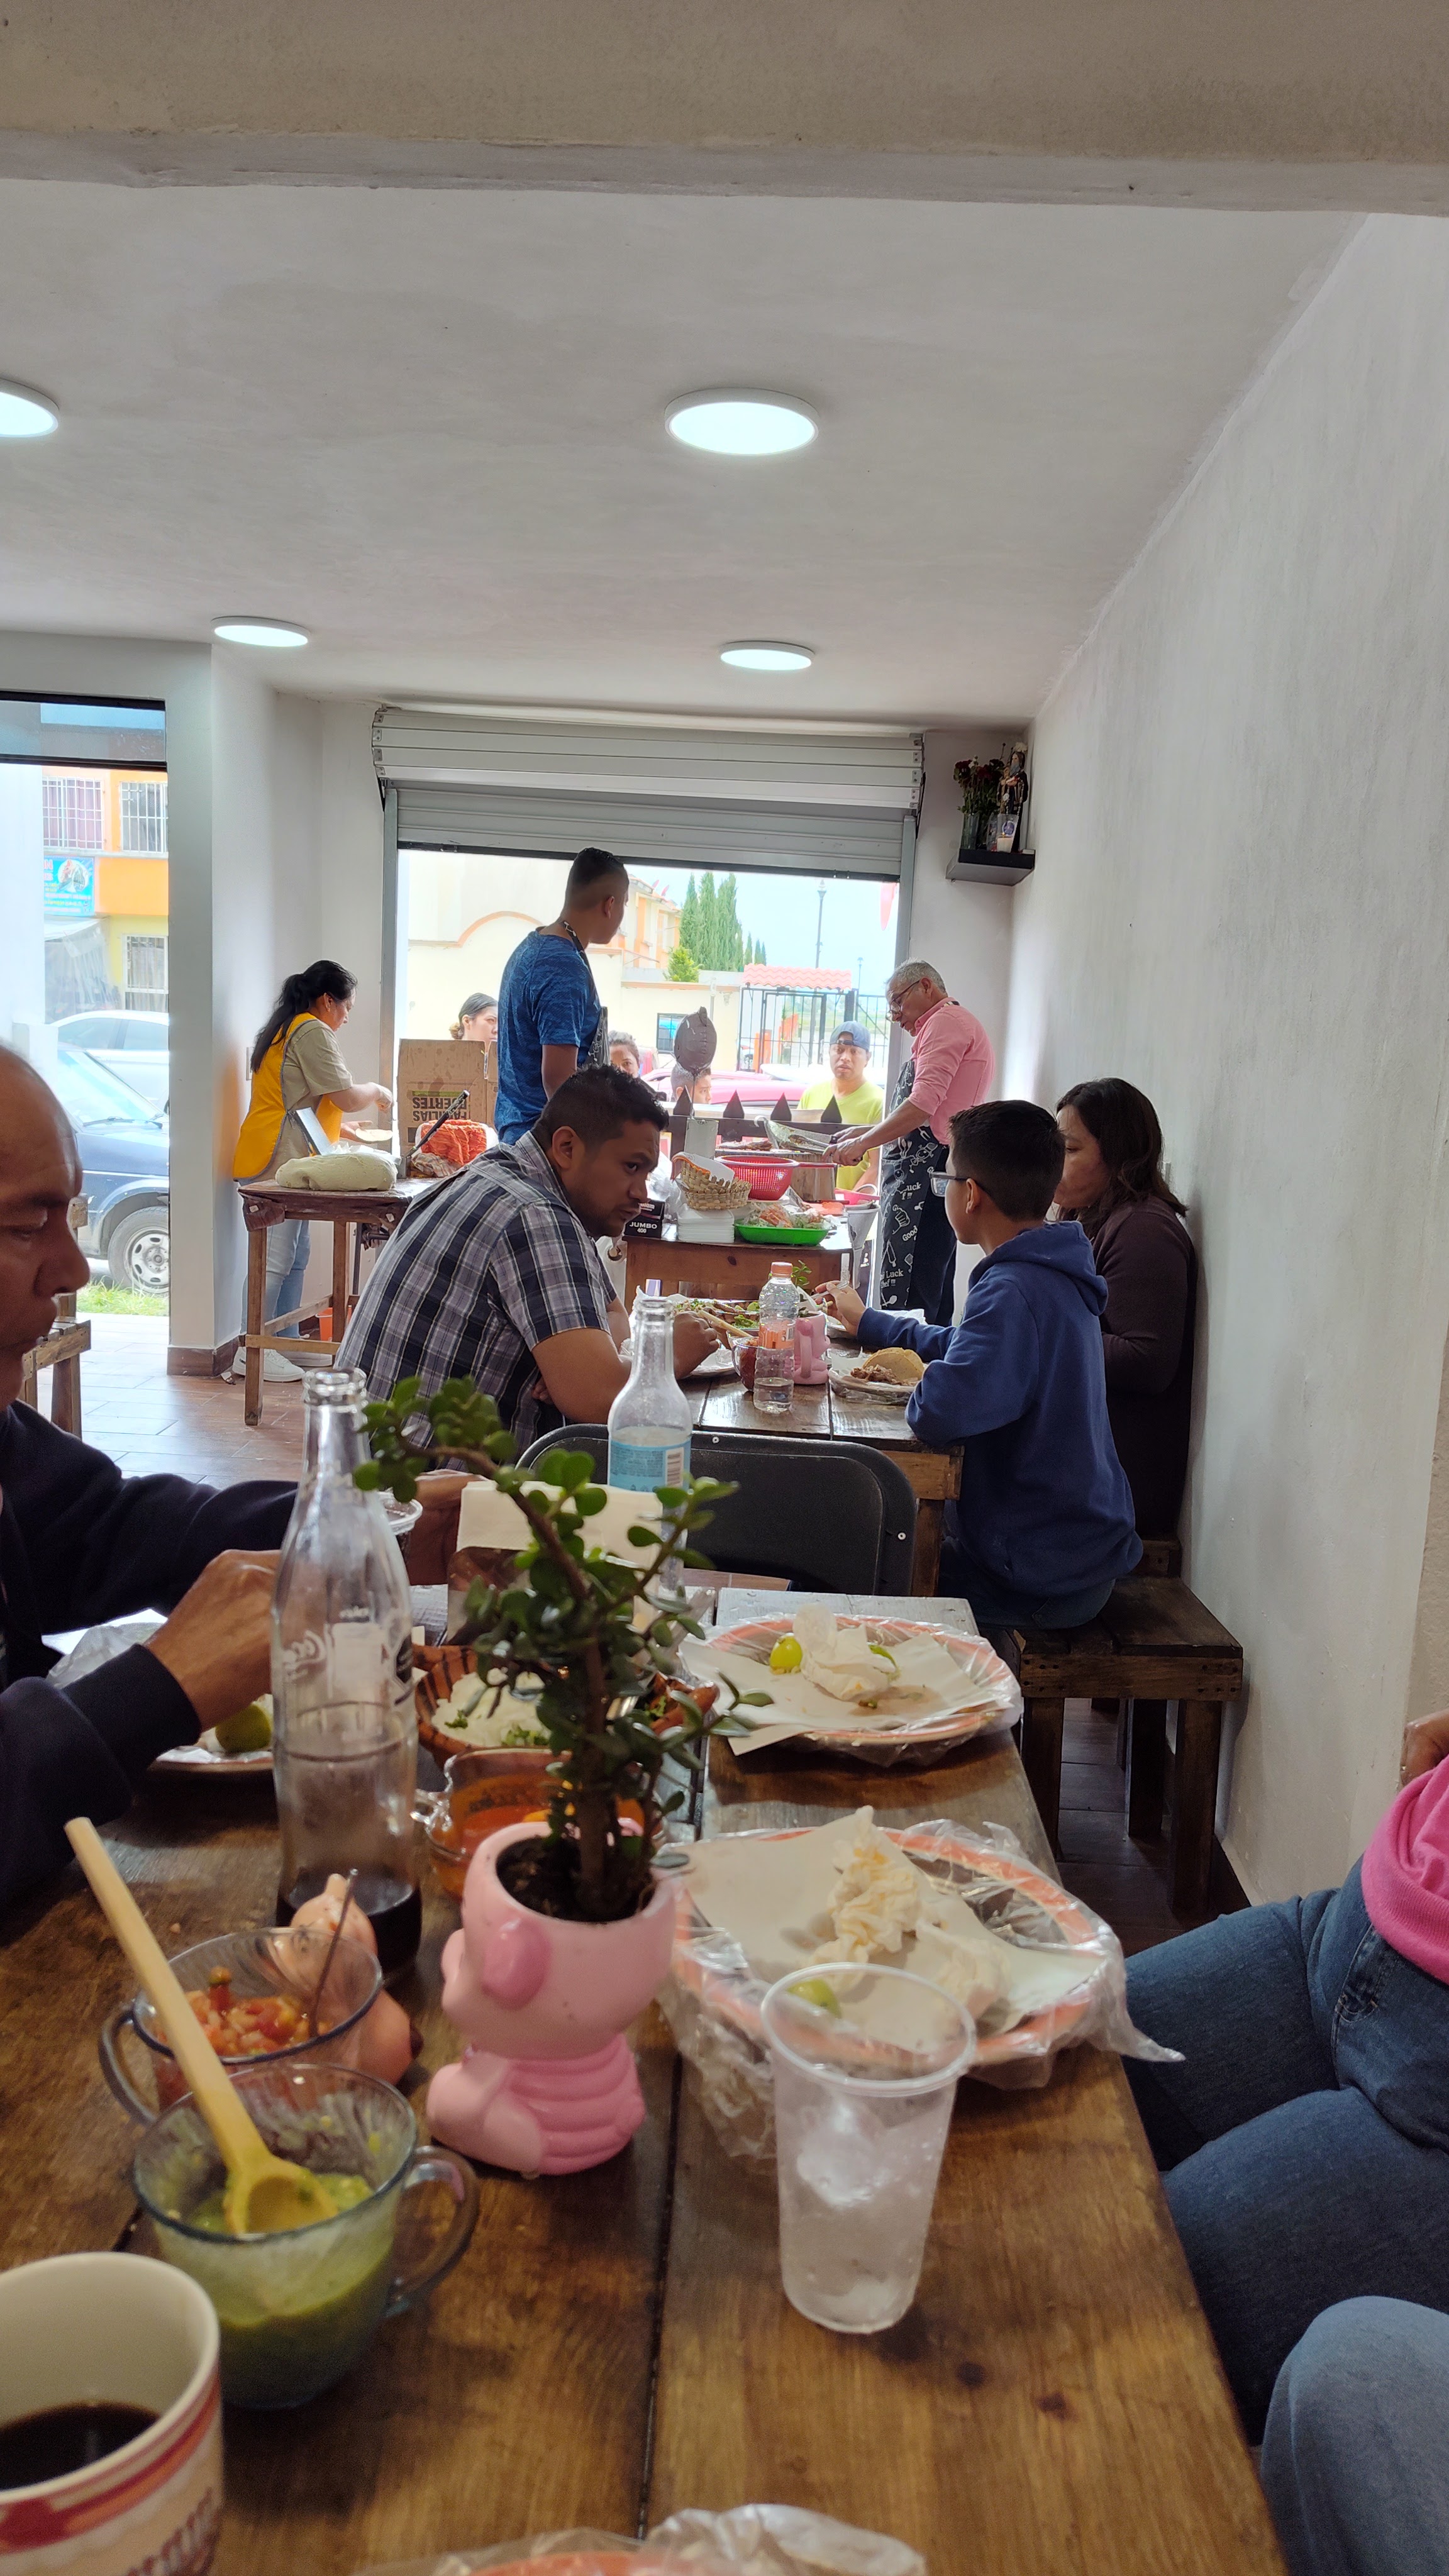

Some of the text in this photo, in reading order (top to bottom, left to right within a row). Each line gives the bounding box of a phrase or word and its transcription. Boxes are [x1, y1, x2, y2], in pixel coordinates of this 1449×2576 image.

[413, 1097, 467, 1109] FERTES
[413, 1111, 467, 1121] FAILIAS
[630, 1221, 657, 1230] JUMBO
[902, 1225, 918, 1241] Good
[886, 1268, 904, 1279] Luck
